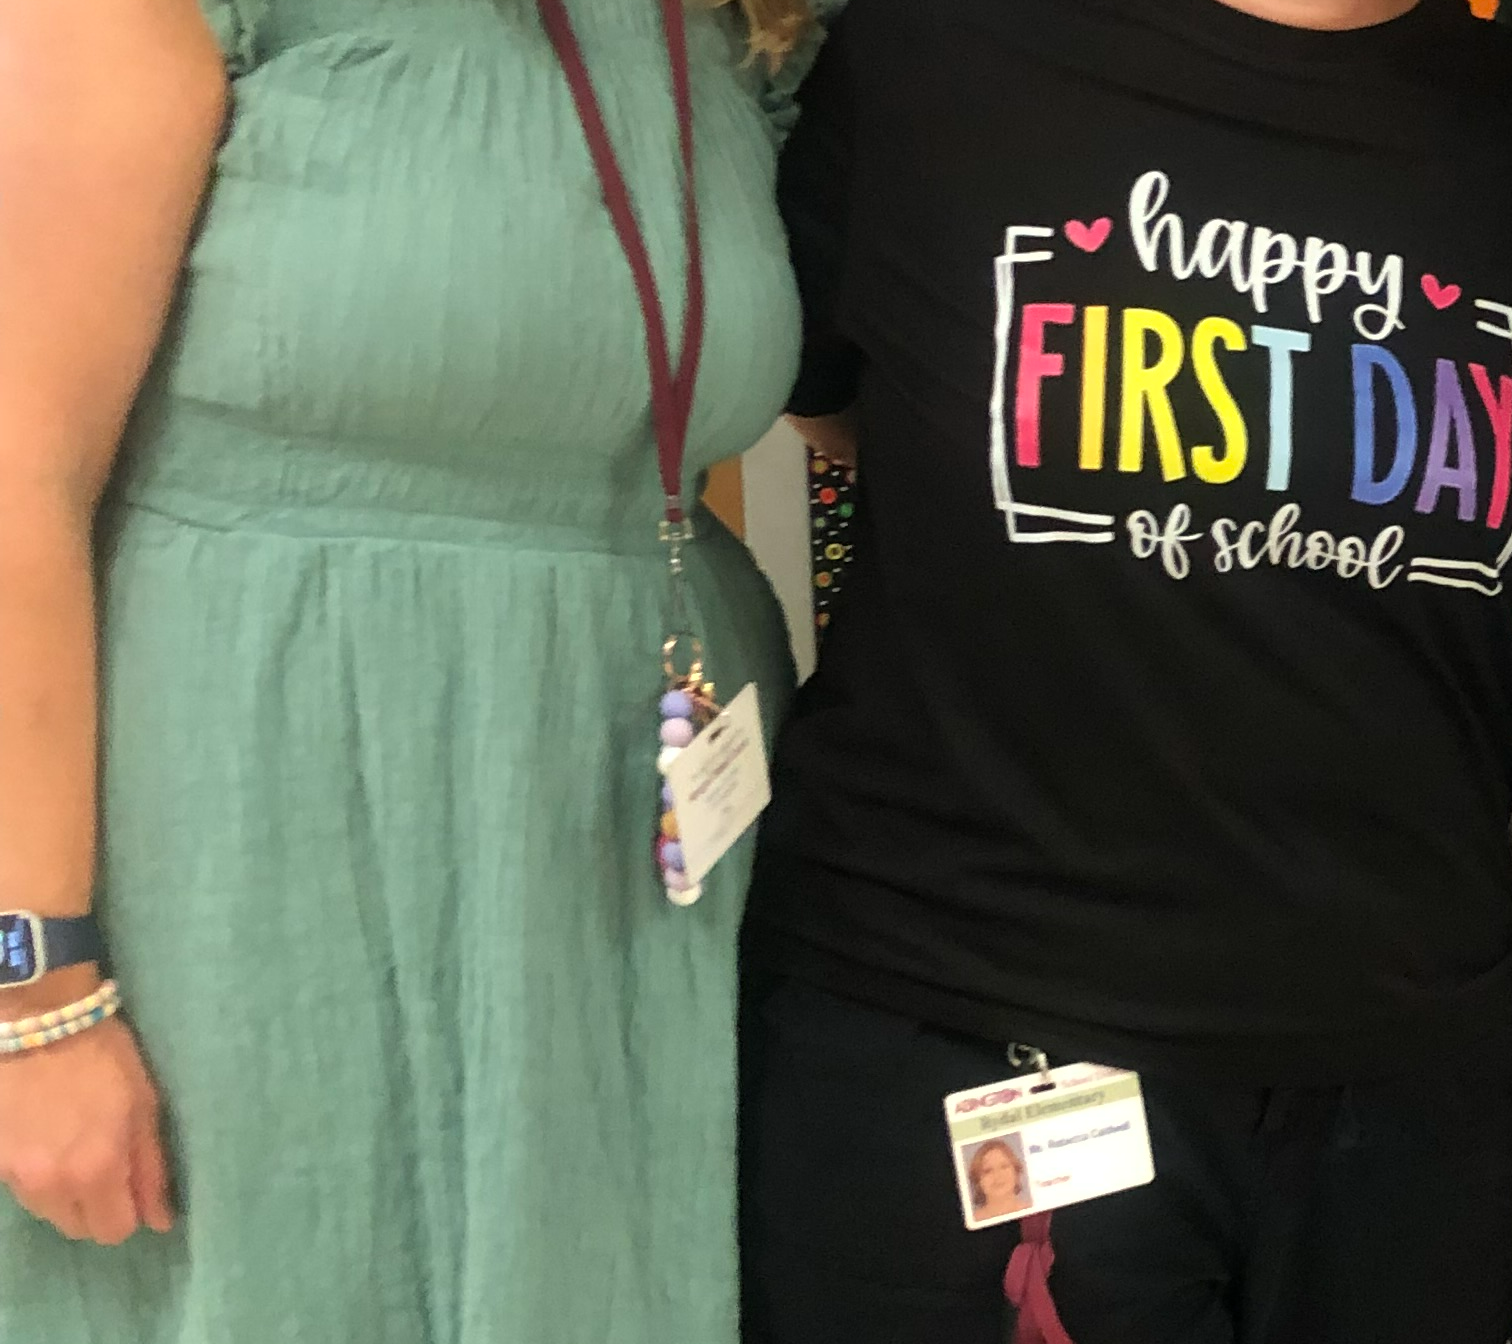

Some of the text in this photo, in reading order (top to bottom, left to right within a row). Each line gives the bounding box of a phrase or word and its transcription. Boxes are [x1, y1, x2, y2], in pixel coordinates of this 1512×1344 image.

[1128, 170, 1407, 341] happy
[1014, 302, 1312, 492] FIRST
[1126, 502, 1405, 591] of school
